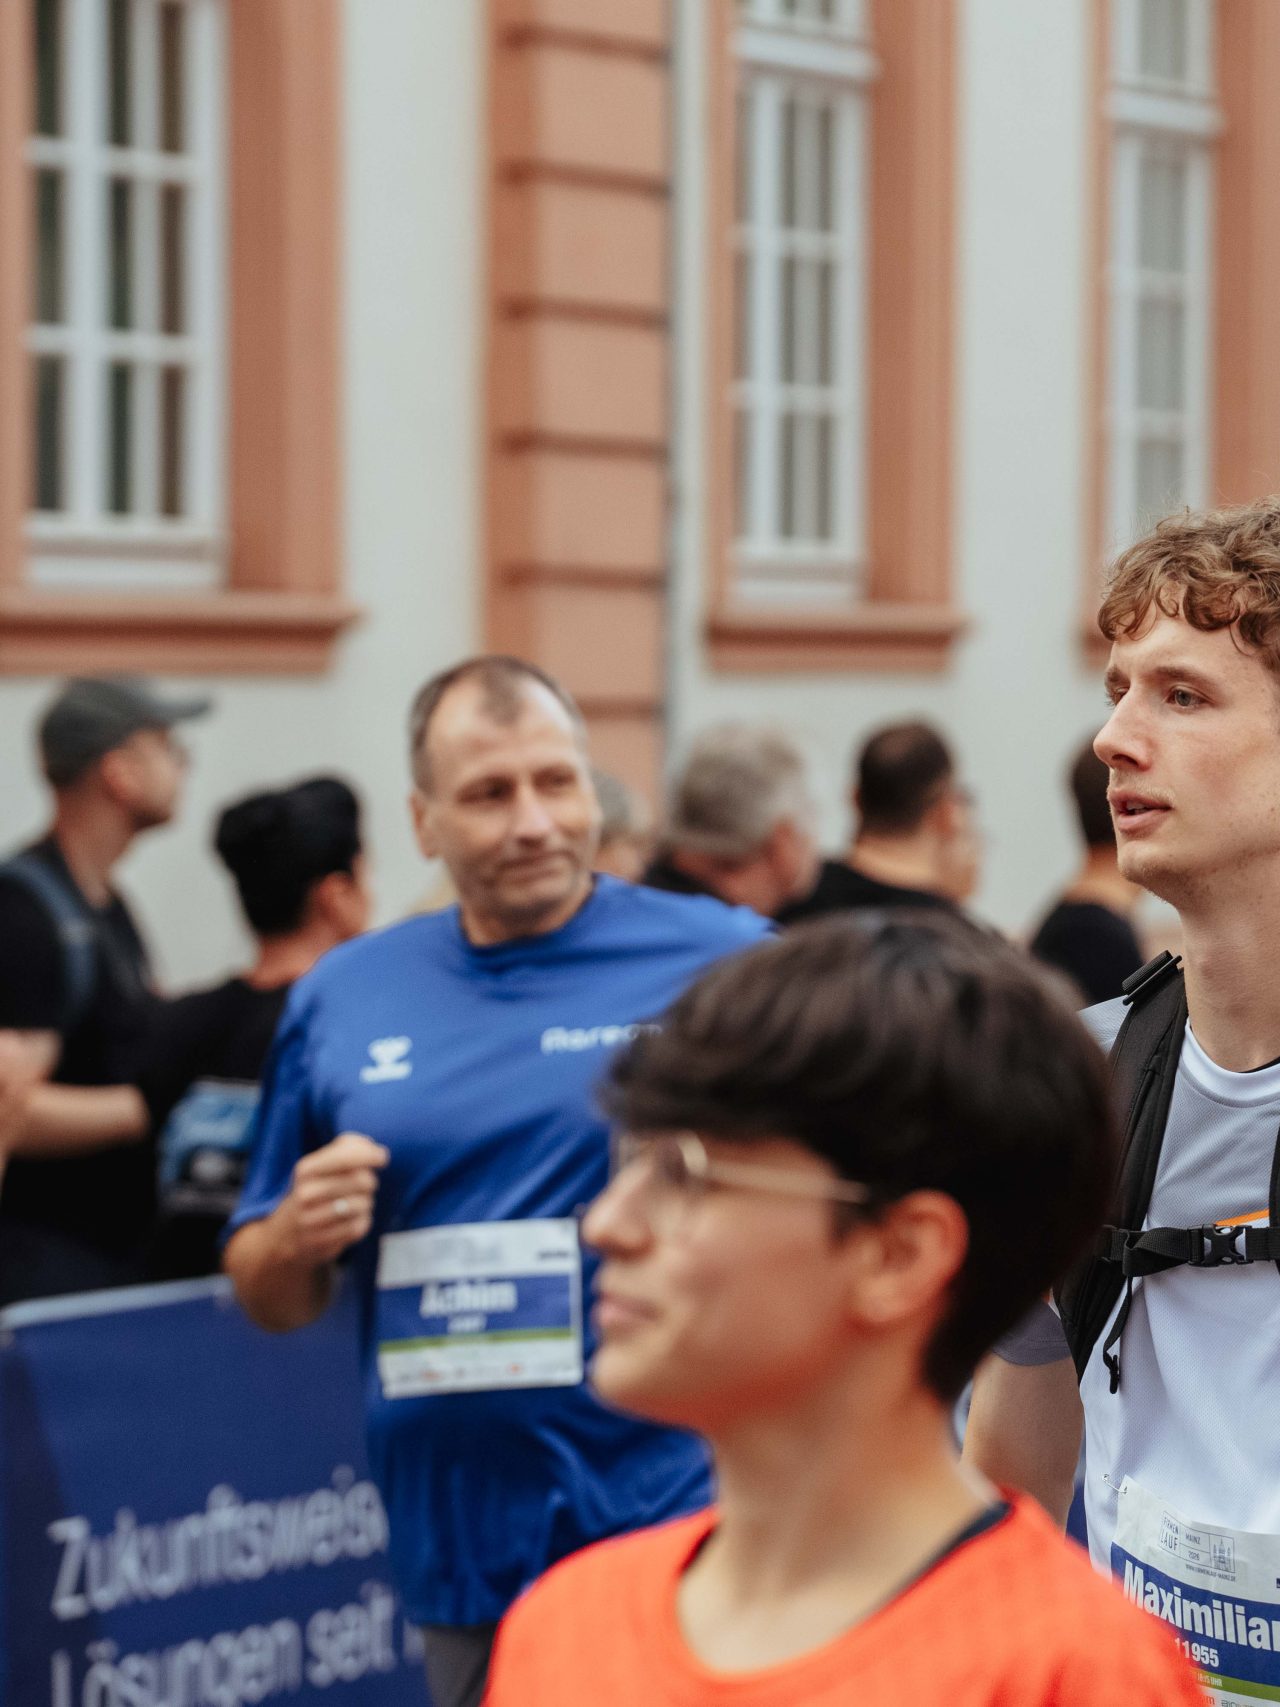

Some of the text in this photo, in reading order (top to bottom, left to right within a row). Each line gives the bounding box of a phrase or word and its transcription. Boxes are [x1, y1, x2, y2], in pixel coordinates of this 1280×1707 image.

[1160, 1528, 1179, 1551] LAUF
[1184, 1531, 1201, 1546] MAINZ
[306, 1580, 397, 1687] seit
[1175, 1637, 1221, 1669] 11955
[1210, 1676, 1223, 1688] UHR
